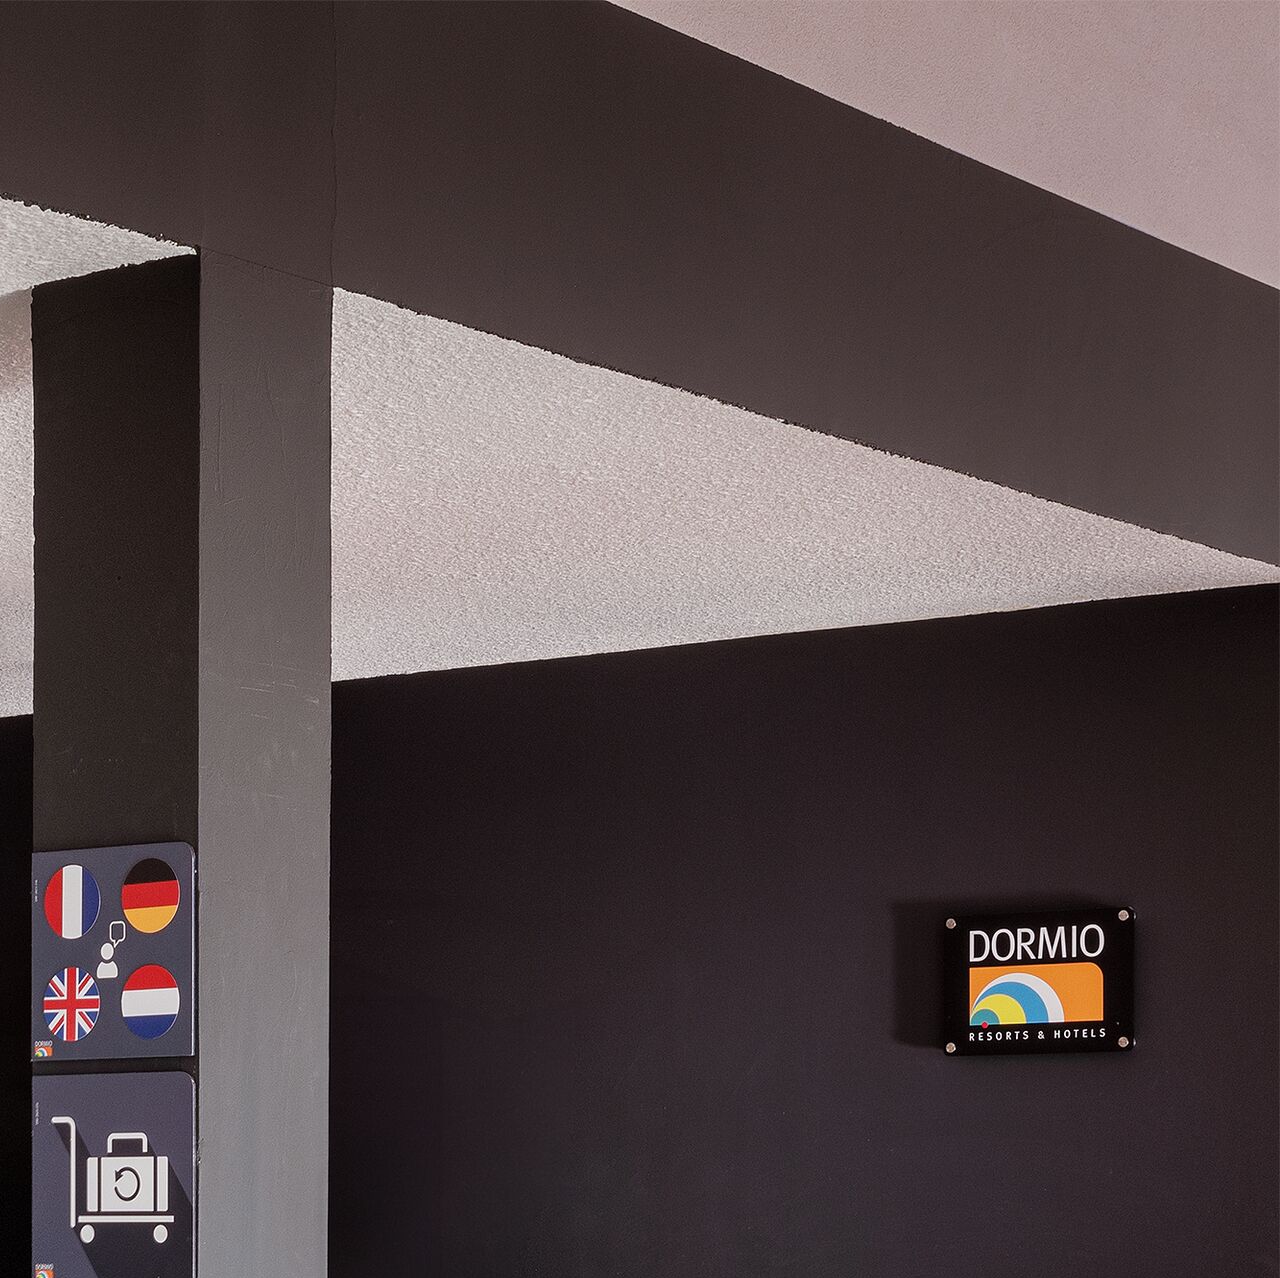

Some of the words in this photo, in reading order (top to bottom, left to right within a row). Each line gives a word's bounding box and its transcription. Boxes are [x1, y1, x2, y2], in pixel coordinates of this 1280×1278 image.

[969, 923, 1105, 963] DORMIO
[969, 1030, 1030, 1041] RESORTS
[1037, 1030, 1045, 1040] &
[1053, 1028, 1107, 1039] HOTELS
